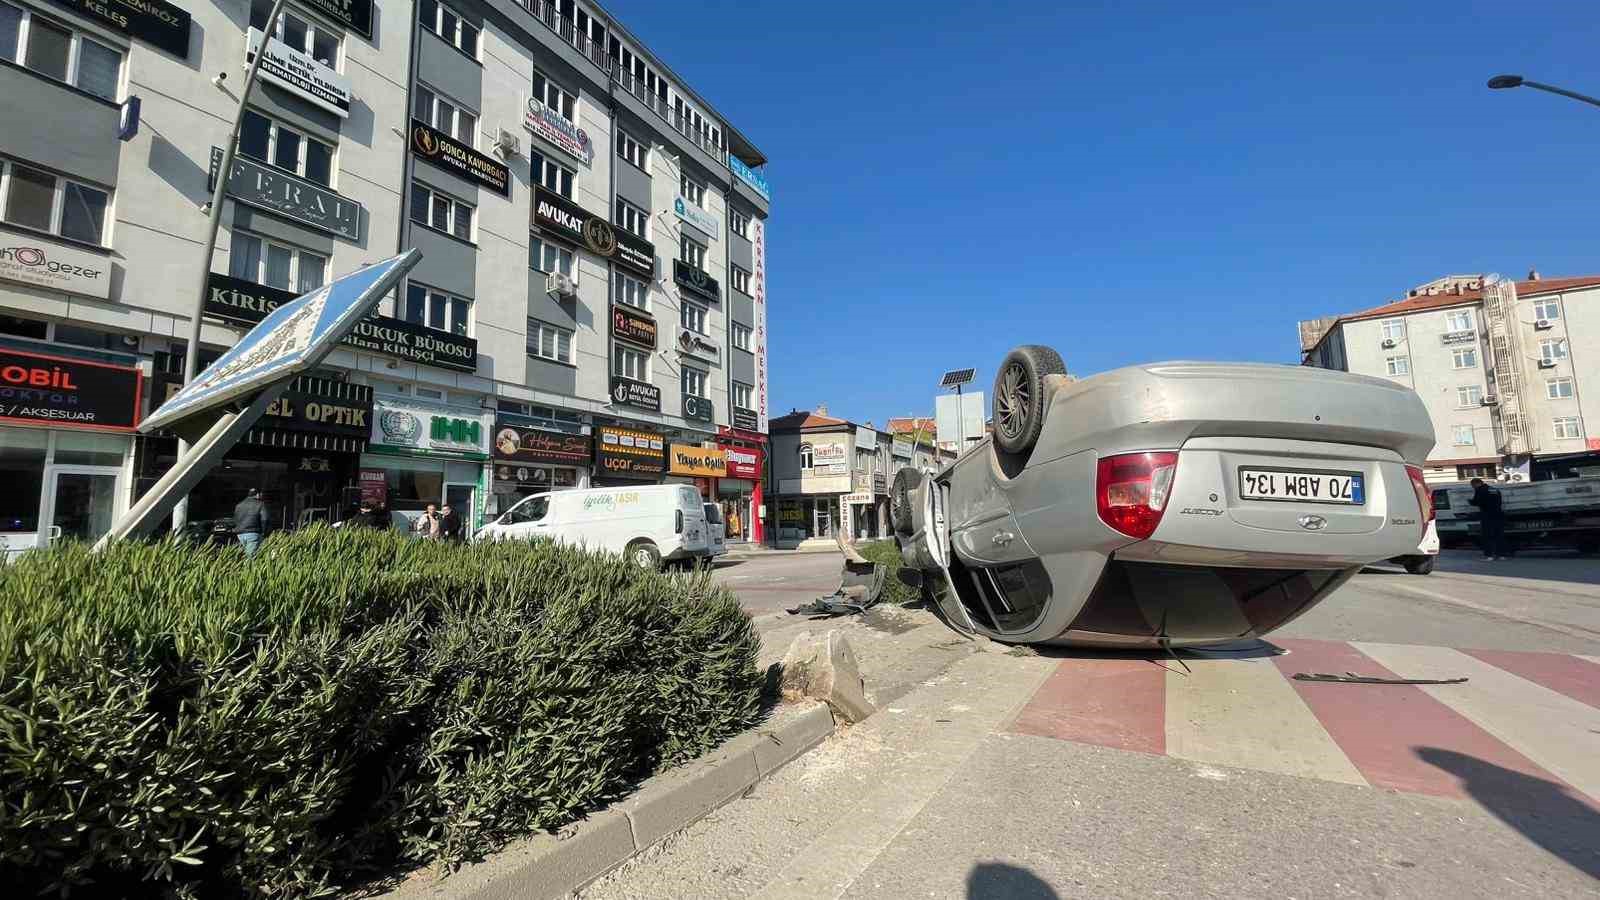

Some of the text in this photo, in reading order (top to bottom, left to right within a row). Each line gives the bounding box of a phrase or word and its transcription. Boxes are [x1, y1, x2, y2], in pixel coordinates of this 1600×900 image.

[440, 140, 467, 161] GONCA
[538, 200, 583, 233] AVUKAT
[47, 261, 102, 279] gezer
[353, 321, 472, 359] UKUK BÜROSU
[630, 384, 658, 399] AVUKAT
[20, 407, 96, 421] AKSESUAR
[305, 402, 367, 427] OPTİK
[1245, 472, 1352, 500] 70 ABM 134
